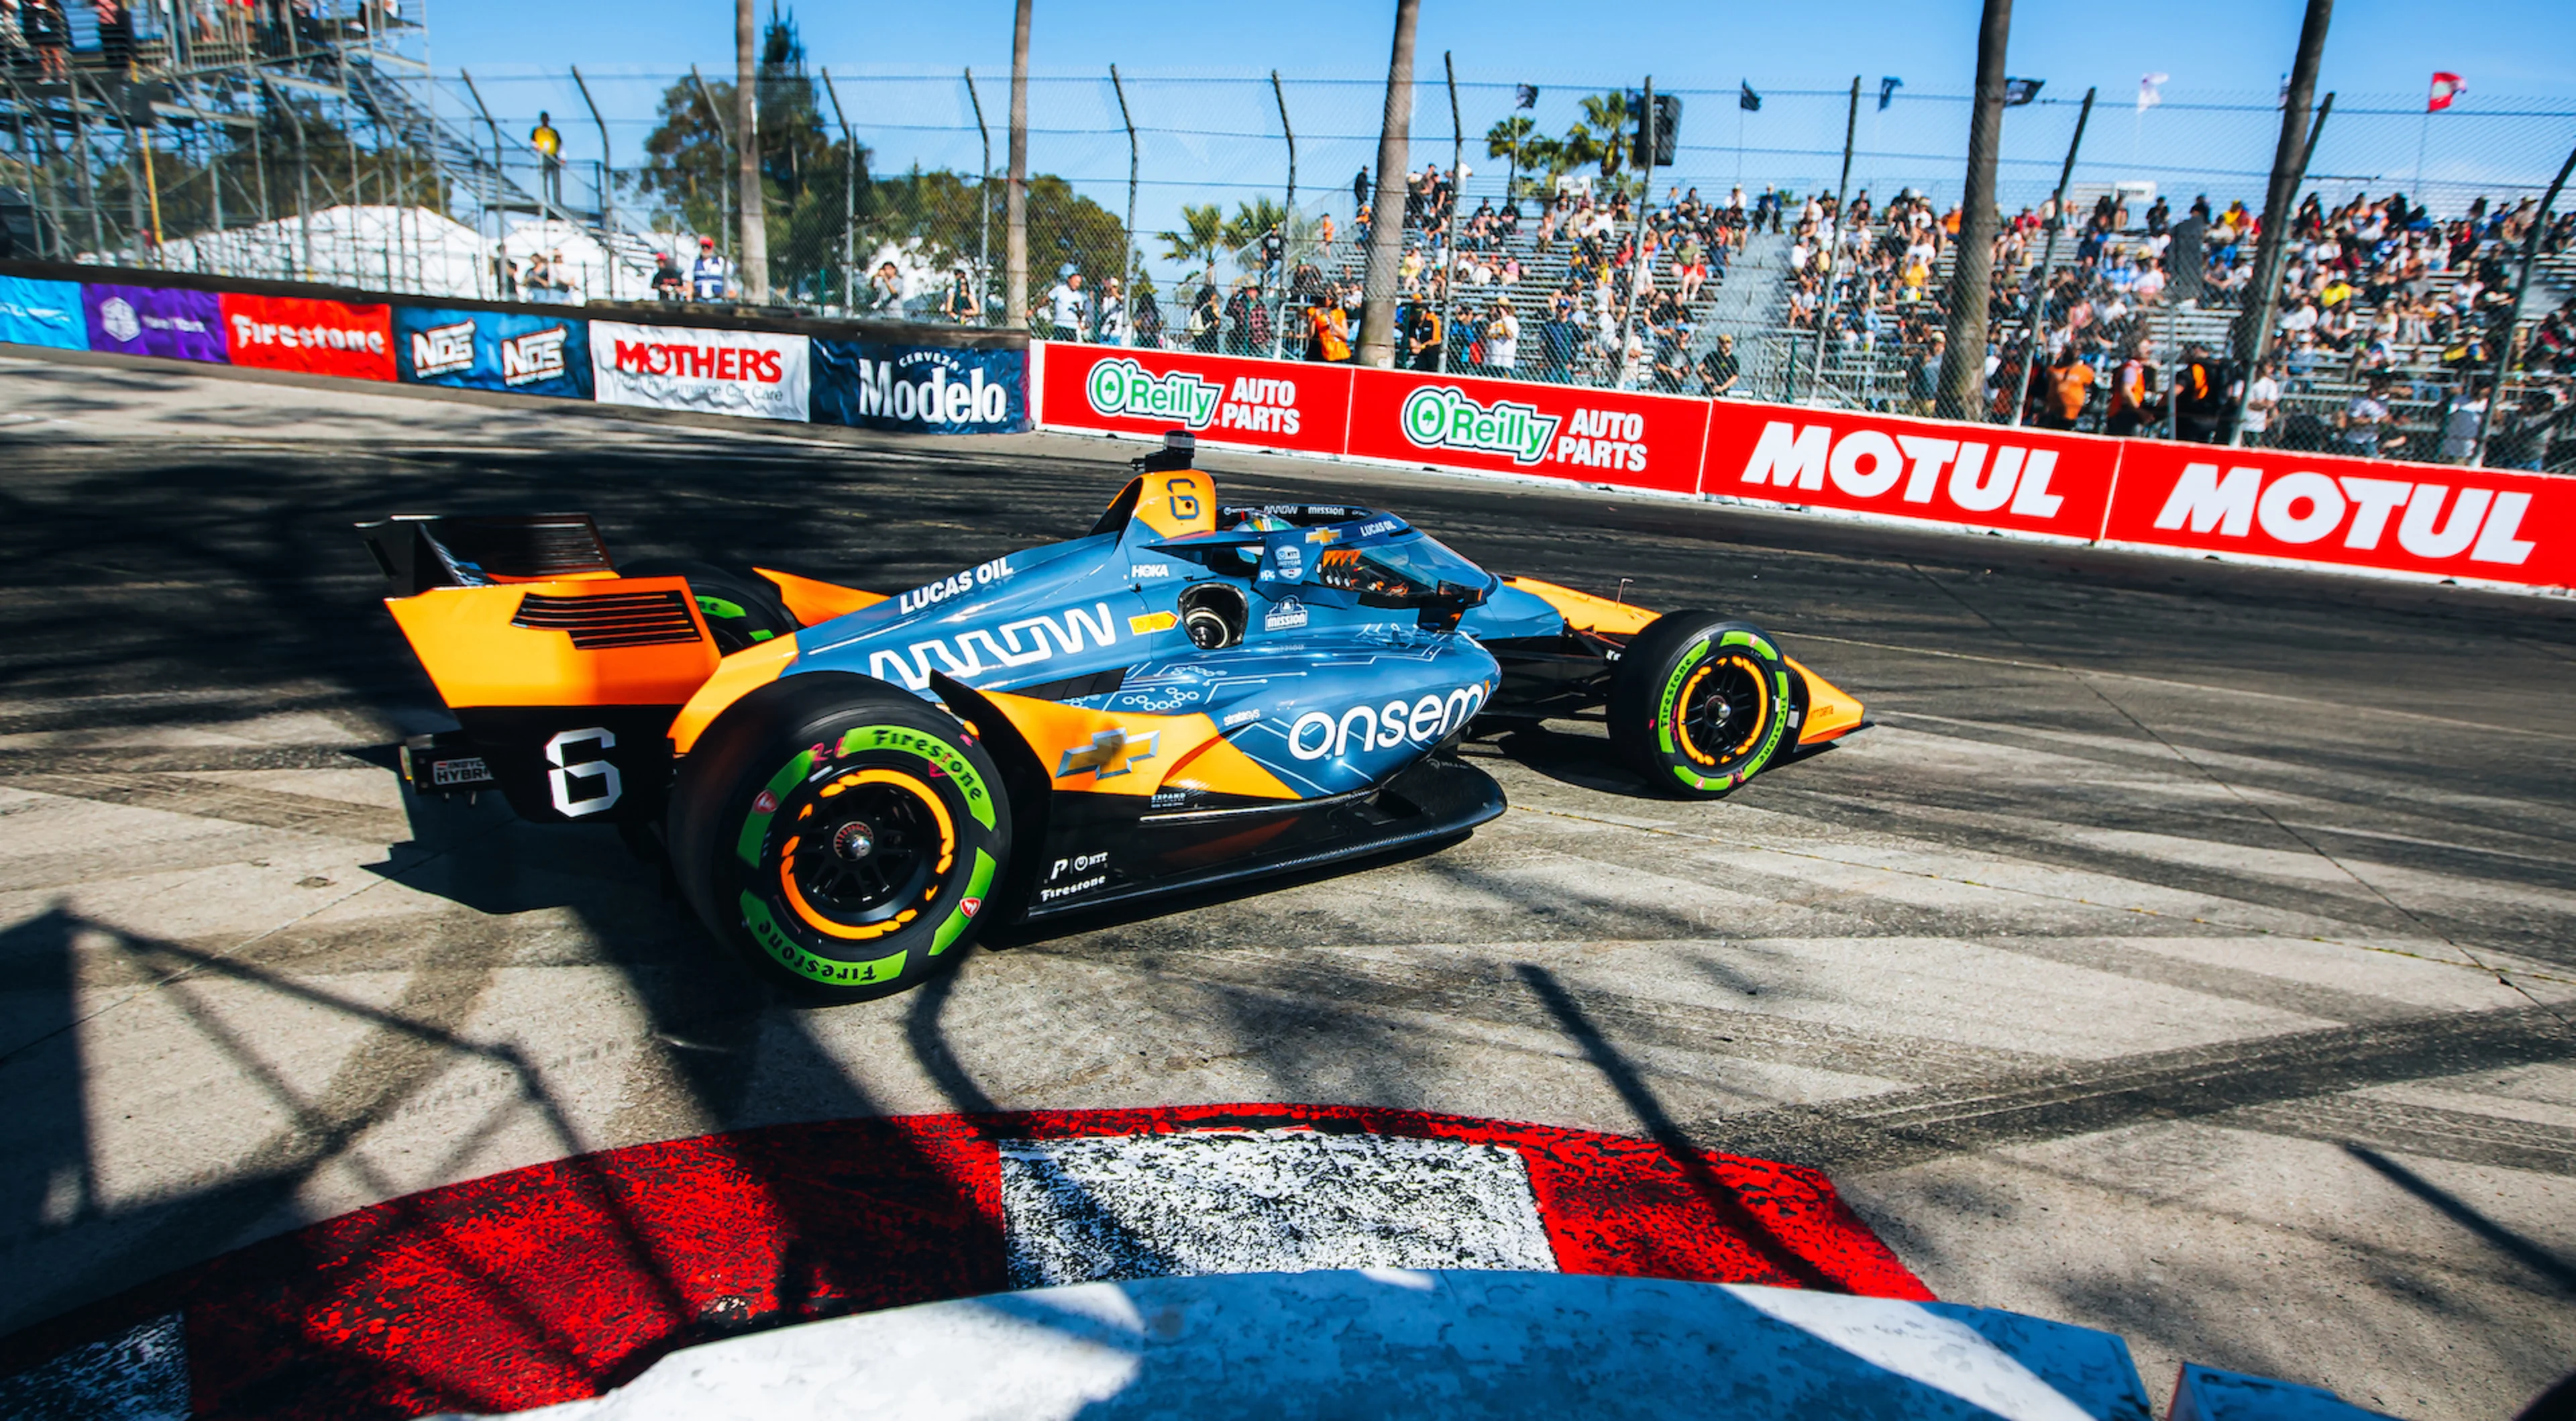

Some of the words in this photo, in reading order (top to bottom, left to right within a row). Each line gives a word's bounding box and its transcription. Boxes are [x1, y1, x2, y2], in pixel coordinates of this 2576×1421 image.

[231, 313, 385, 354] Firestone
[412, 317, 476, 370] NOS
[502, 323, 567, 378] NOS
[615, 339, 782, 383] MOTHERS
[898, 352, 960, 371] CERVEZA
[726, 383, 745, 397] Car
[752, 386, 783, 401] Care
[859, 358, 1007, 424] Modelo
[1095, 367, 1212, 421] O'Reilly
[1231, 377, 1295, 407] AUTO
[1222, 403, 1300, 435] PARTS
[1411, 396, 1546, 454] O'Reilly
[1568, 409, 1644, 442] AUTO
[1556, 437, 1647, 471] PARTS
[1740, 421, 2064, 518] MOTUL
[1167, 478, 1199, 519] 6
[2153, 463, 2536, 564] MOTUL
[1360, 521, 1385, 537] LUCAS
[900, 570, 973, 615] LUCAS
[977, 557, 1013, 584] OIL
[1132, 564, 1169, 577] HOKA
[1660, 658, 1692, 728] Firestone
[1759, 696, 1788, 762] Firestone
[437, 768, 488, 782] HYBR
[544, 727, 622, 817] 6
[873, 729, 982, 800] Firestone
[1040, 875, 1106, 902] Firestone
[758, 920, 877, 982] Firestone
